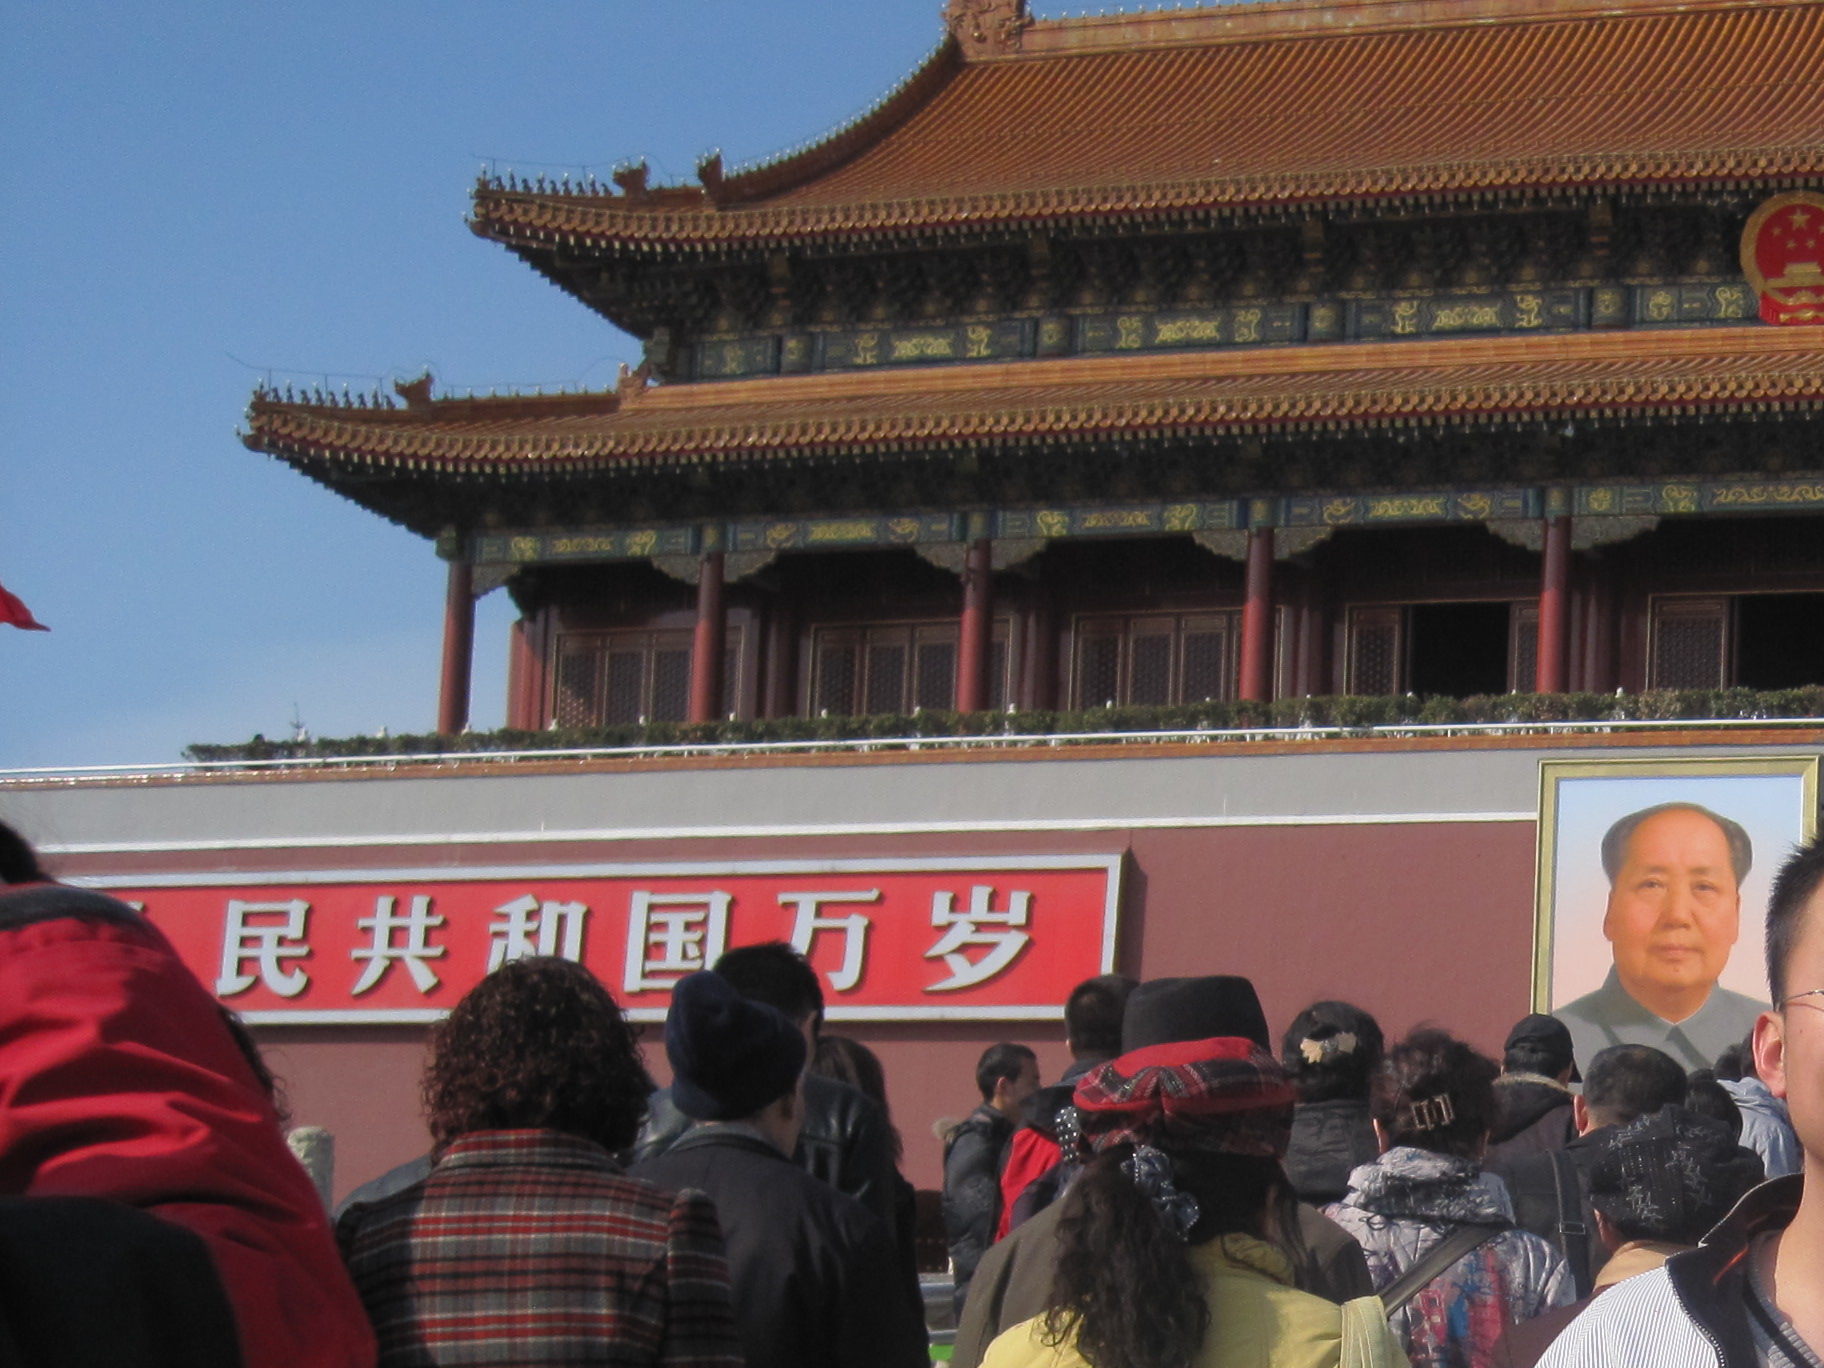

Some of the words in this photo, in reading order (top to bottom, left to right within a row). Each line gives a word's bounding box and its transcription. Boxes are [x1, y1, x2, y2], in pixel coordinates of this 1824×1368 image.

[127, 885, 1032, 999] 民共和国万岁
